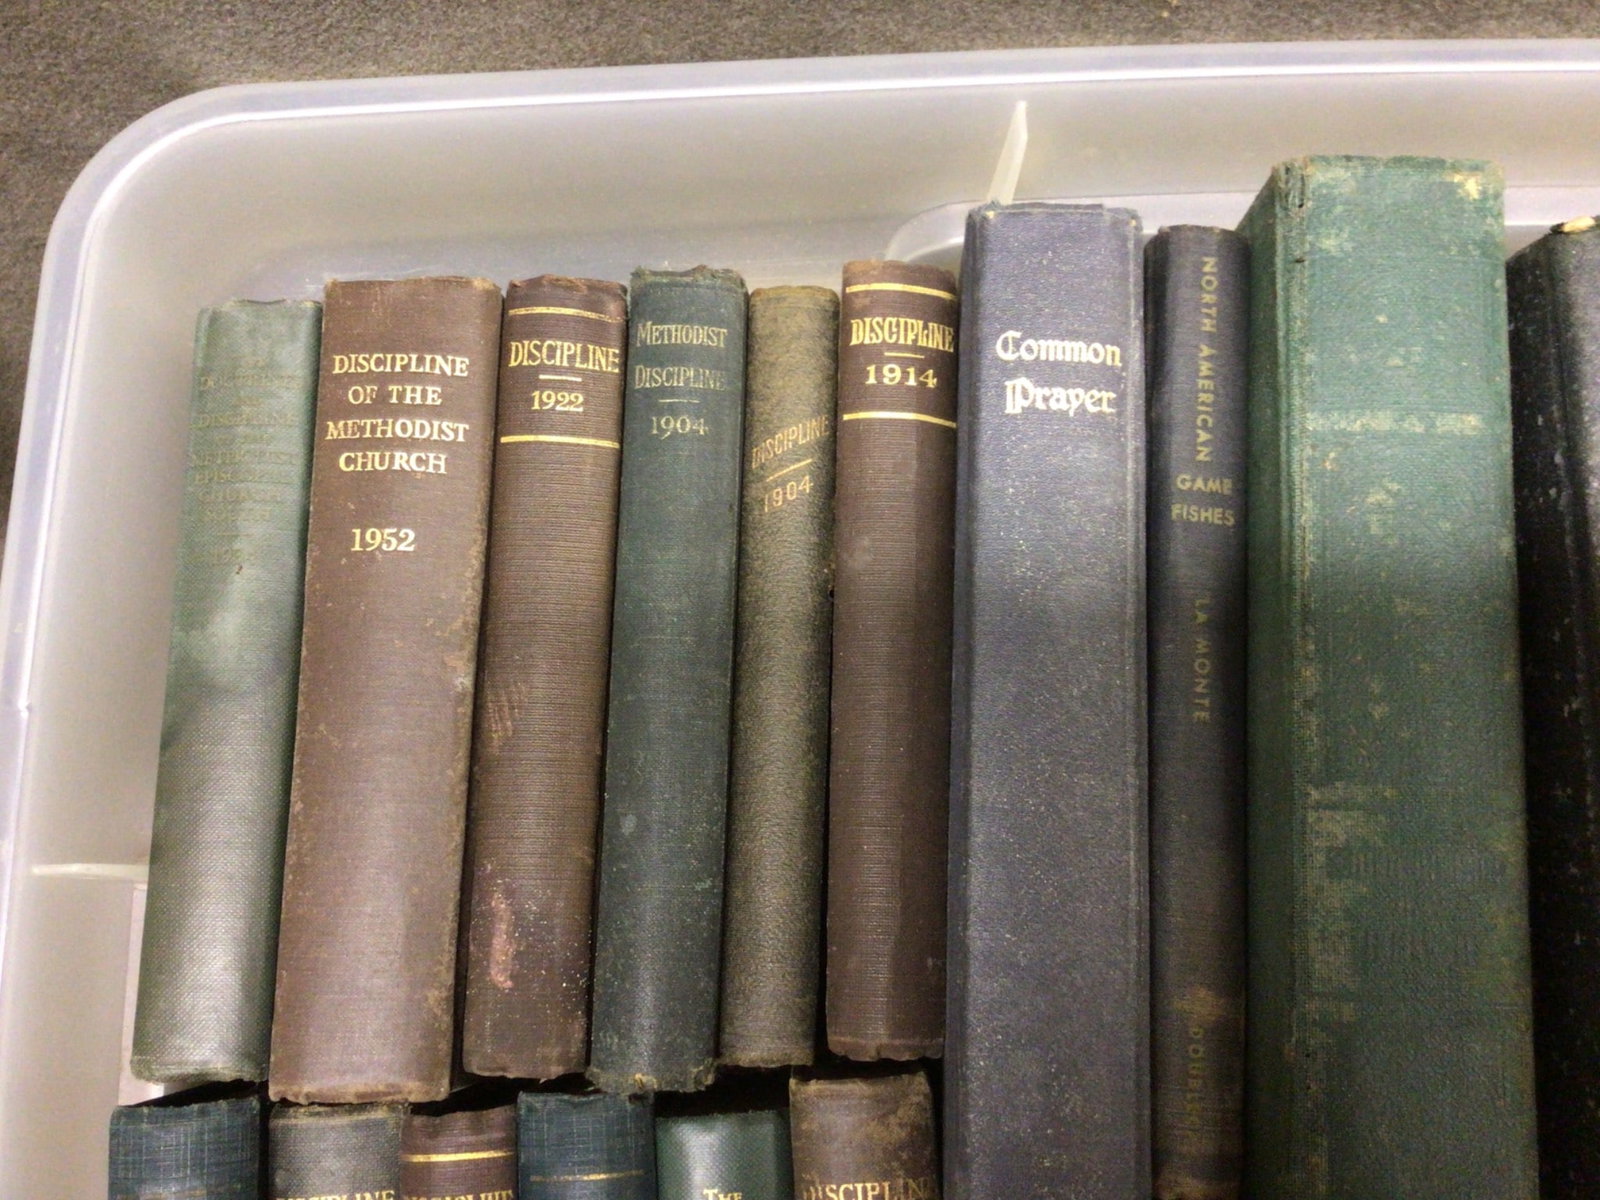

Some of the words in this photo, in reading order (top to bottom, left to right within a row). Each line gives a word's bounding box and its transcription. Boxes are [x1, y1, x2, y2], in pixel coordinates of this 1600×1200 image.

[1200, 256, 1219, 332] NORTH
[636, 320, 729, 348] METHODIST
[849, 316, 955, 353] DISCIPLINE
[508, 340, 620, 374] DISCIPLINE
[995, 330, 1122, 367] Common
[332, 353, 470, 377] DISCIPLINE
[634, 364, 727, 391] DISCIPLINE
[865, 363, 938, 388] 1914
[347, 385, 378, 405] OF
[388, 384, 443, 406] THE
[530, 390, 585, 413] 1922
[1003, 376, 1117, 418] Prayer
[1195, 344, 1218, 462] AMERICAN
[324, 419, 470, 443] METHODIST
[650, 415, 710, 441] 1904
[751, 414, 830, 470] DISCIPLINE
[338, 451, 448, 475] CHURCH
[763, 474, 814, 513] 1904
[1176, 473, 1233, 496] GAME
[1171, 503, 1235, 527] FISHES
[350, 527, 416, 552] 1952
[1192, 637, 1211, 724] MONTE
[802, 1179, 937, 1200] DISCIPLIN
